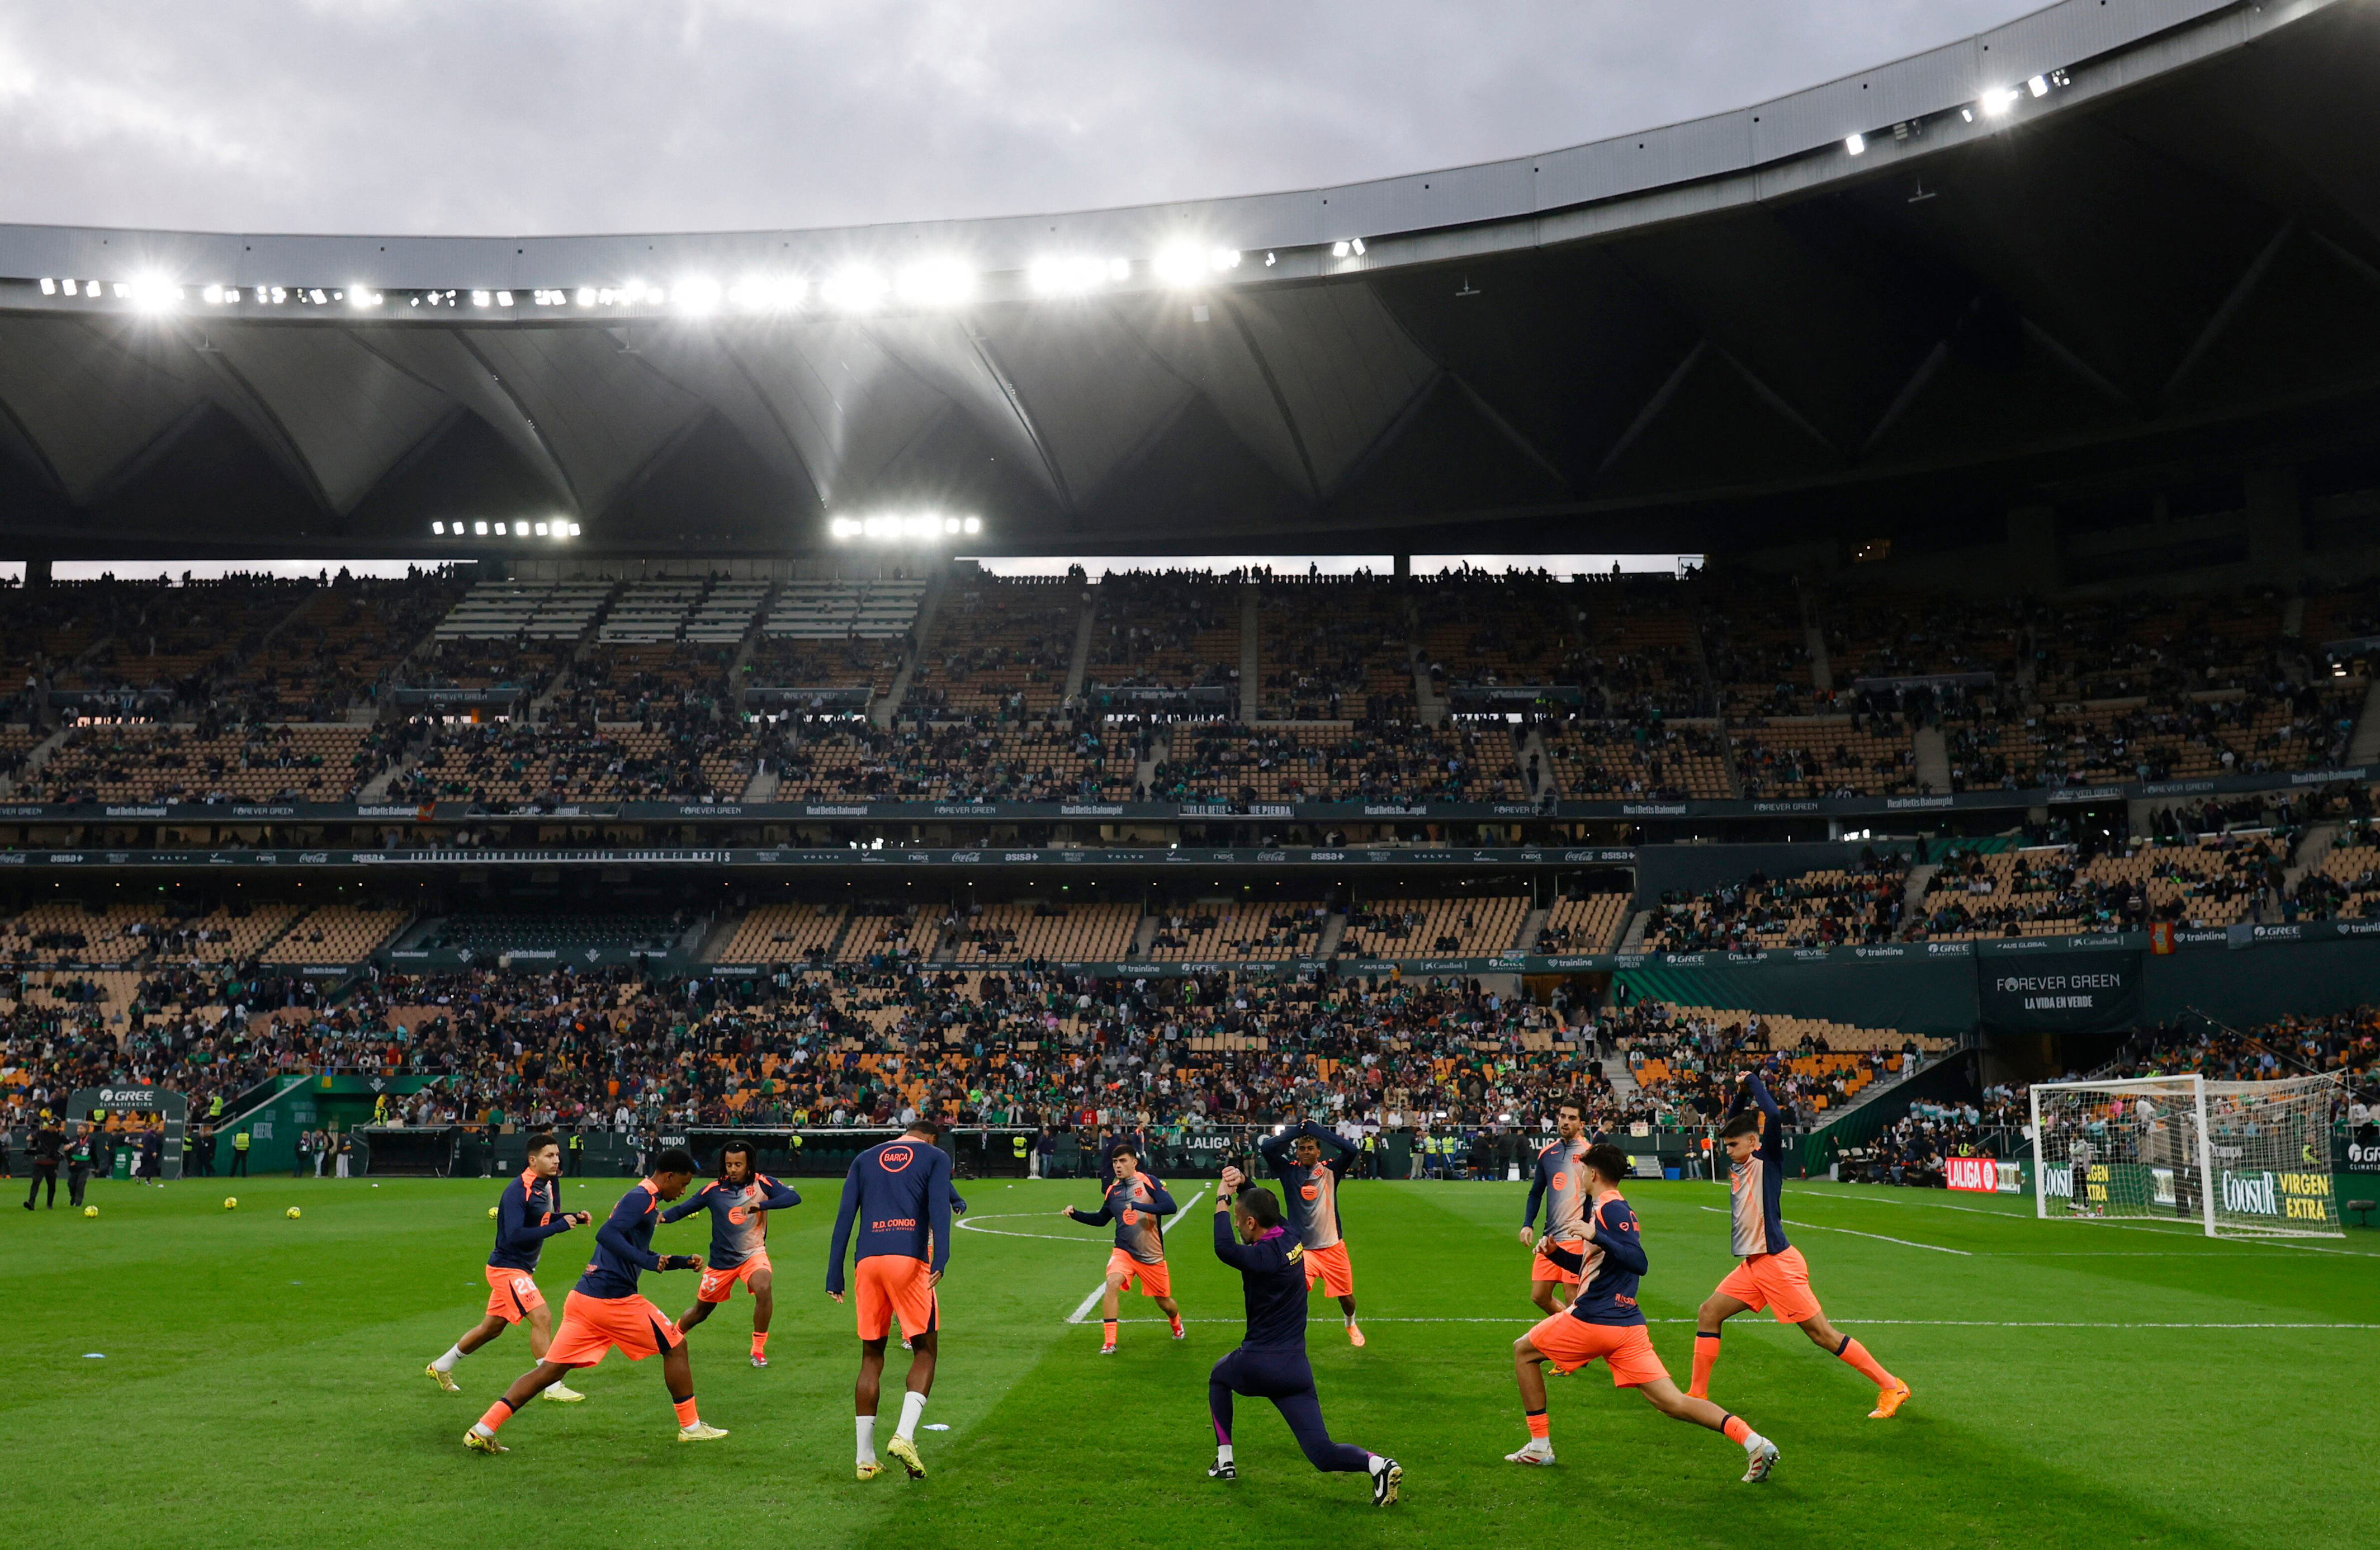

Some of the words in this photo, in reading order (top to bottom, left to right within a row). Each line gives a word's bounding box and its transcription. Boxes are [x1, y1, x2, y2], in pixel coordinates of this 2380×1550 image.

[2292, 774, 2308, 783] Real
[2147, 784, 2183, 794] OREVER
[1887, 799, 1902, 808] Real
[1903, 798, 1920, 807] Betis
[1920, 796, 1953, 807] Balompié
[358, 806, 372, 815] Real
[372, 806, 388, 815] Betis
[389, 806, 418, 816] Balompié
[838, 806, 868, 816] Balompié
[1062, 806, 1075, 814] Real
[1076, 806, 1091, 814] Betis
[1092, 806, 1123, 815] Balompié
[1199, 805, 1206, 814] EL
[1208, 805, 1226, 814] BETIS
[1262, 806, 1290, 814] PIERDA
[1365, 806, 1378, 814] Real
[1379, 806, 1395, 814] Betis
[1624, 806, 1638, 814] Real
[1638, 805, 1654, 814] Betis
[1654, 804, 1686, 815] Balompié
[2268, 926, 2301, 935] GREE
[2351, 923, 2380, 933] trainli
[2187, 932, 2226, 942] trainline
[1868, 947, 1903, 956] trainline
[1997, 977, 2065, 991] FOREVER
[2071, 974, 2120, 989] GREEN
[2025, 998, 2034, 1009] LA
[2036, 998, 2055, 1009] VIDA
[2056, 996, 2066, 1009] EN
[2067, 996, 2093, 1008] VERDE
[115, 1090, 154, 1101] GREE
[1186, 1137, 1231, 1149] LALIGA
[884, 1153, 907, 1162] BARÇA
[2363, 1147, 2380, 1162] GR
[1947, 1161, 1981, 1189] LALIGA
[2278, 1173, 2329, 1196] VIRGEN
[2087, 1184, 2108, 1202] XTRA
[2286, 1197, 2326, 1221] EXTRA
[887, 1218, 916, 1227] CONGO
